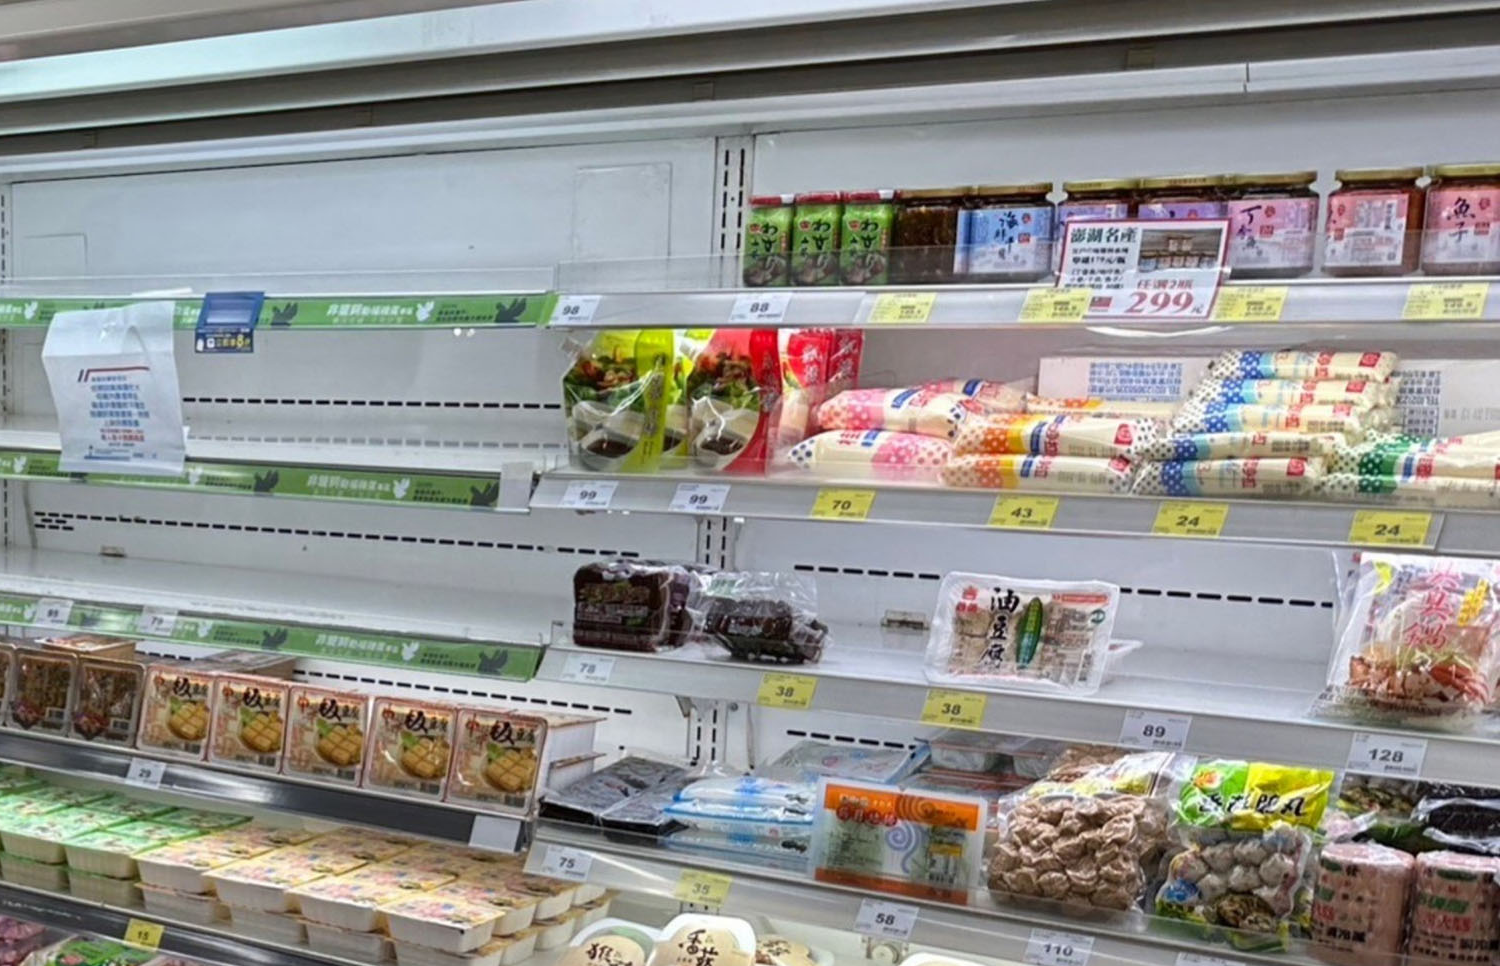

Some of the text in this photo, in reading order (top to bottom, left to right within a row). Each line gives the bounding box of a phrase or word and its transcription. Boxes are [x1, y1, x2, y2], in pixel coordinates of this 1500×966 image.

[1446, 197, 1476, 243] 魚子
[1070, 228, 1137, 244] 澎湖名產
[562, 304, 581, 316] 98
[750, 302, 769, 313] 88
[579, 490, 597, 501] 99
[690, 494, 708, 504] 99
[832, 499, 852, 511] 70
[1011, 507, 1032, 519] 43
[1176, 514, 1200, 527] 24
[1374, 523, 1400, 536] 24
[981, 587, 1020, 668] 油豆腐
[579, 662, 596, 674] 78
[775, 686, 794, 698] 38
[941, 703, 961, 715] 38
[1142, 725, 1166, 738] 89
[1368, 748, 1404, 762] 128
[558, 856, 575, 868] 75
[692, 882, 710, 895] 35
[875, 912, 896, 926] 58
[1042, 943, 1073, 957] 110
